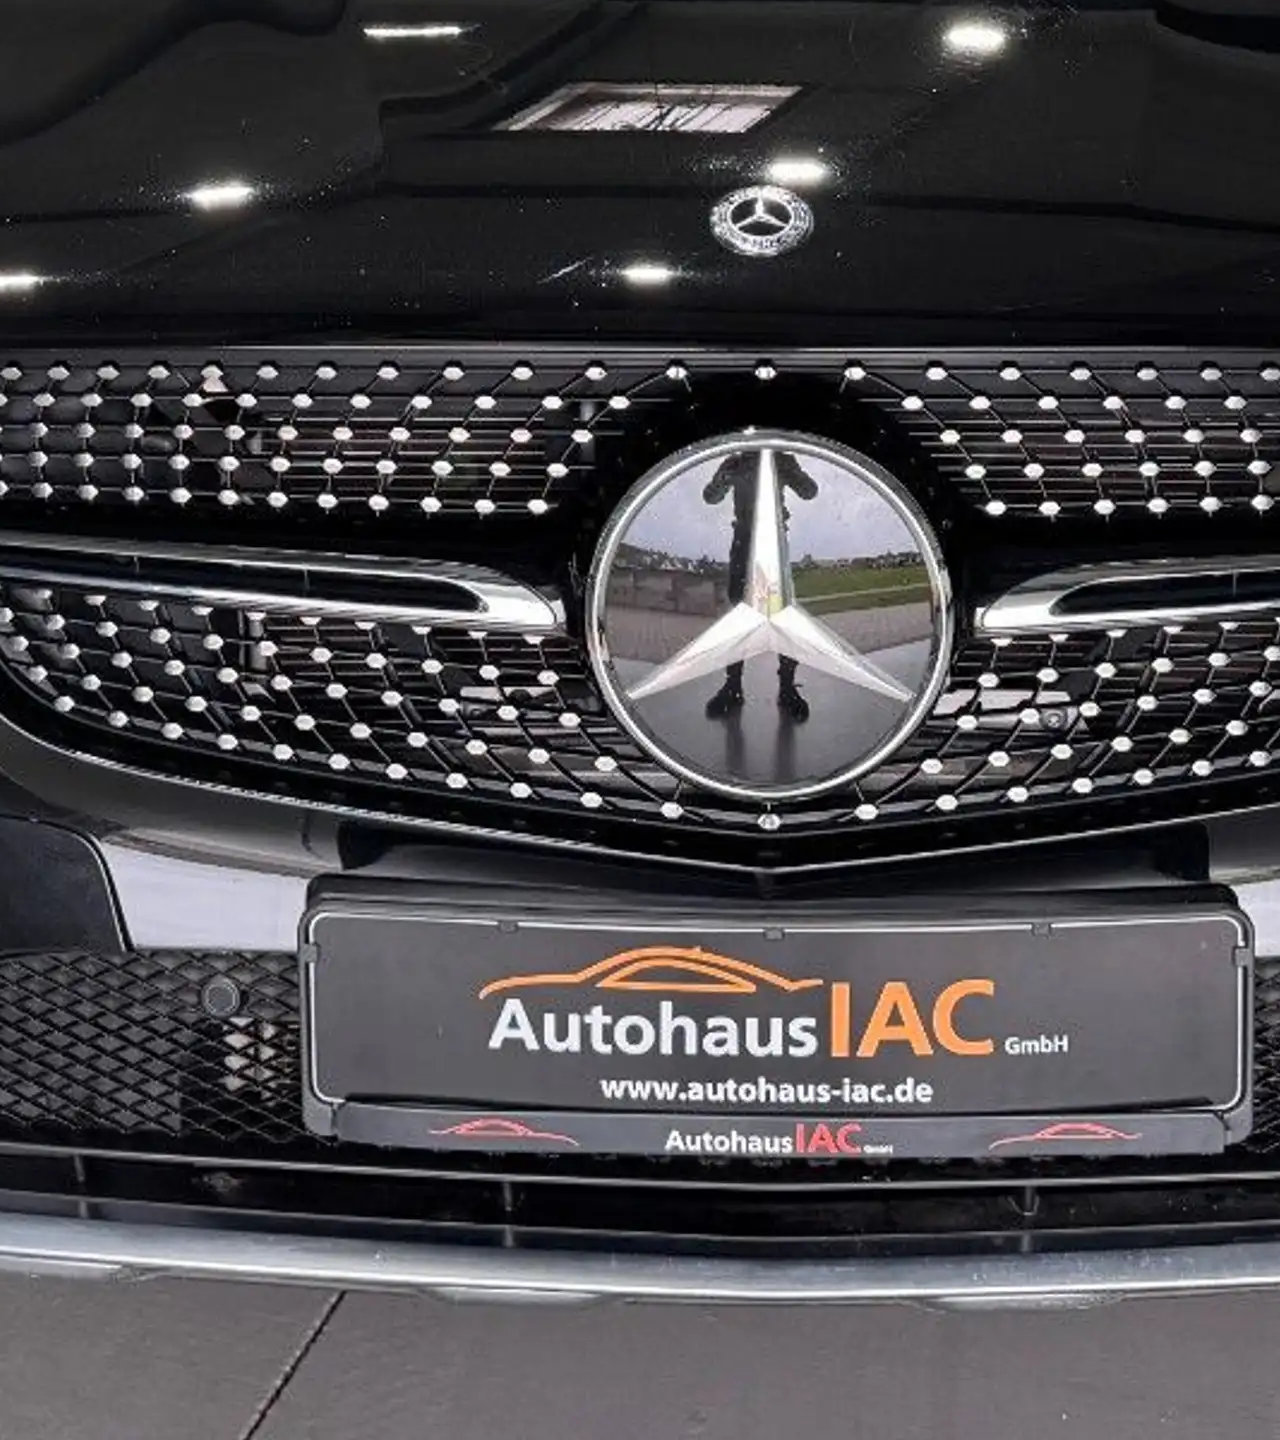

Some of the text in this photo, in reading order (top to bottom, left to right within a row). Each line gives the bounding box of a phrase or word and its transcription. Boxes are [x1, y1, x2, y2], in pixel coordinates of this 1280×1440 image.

[488, 978, 1069, 1058] Autohaus IAC GmbH
[600, 1077, 933, 1105] www.autohaus-iac.de
[665, 1129, 793, 1155] Autohaus
[796, 1122, 862, 1154] IAC
